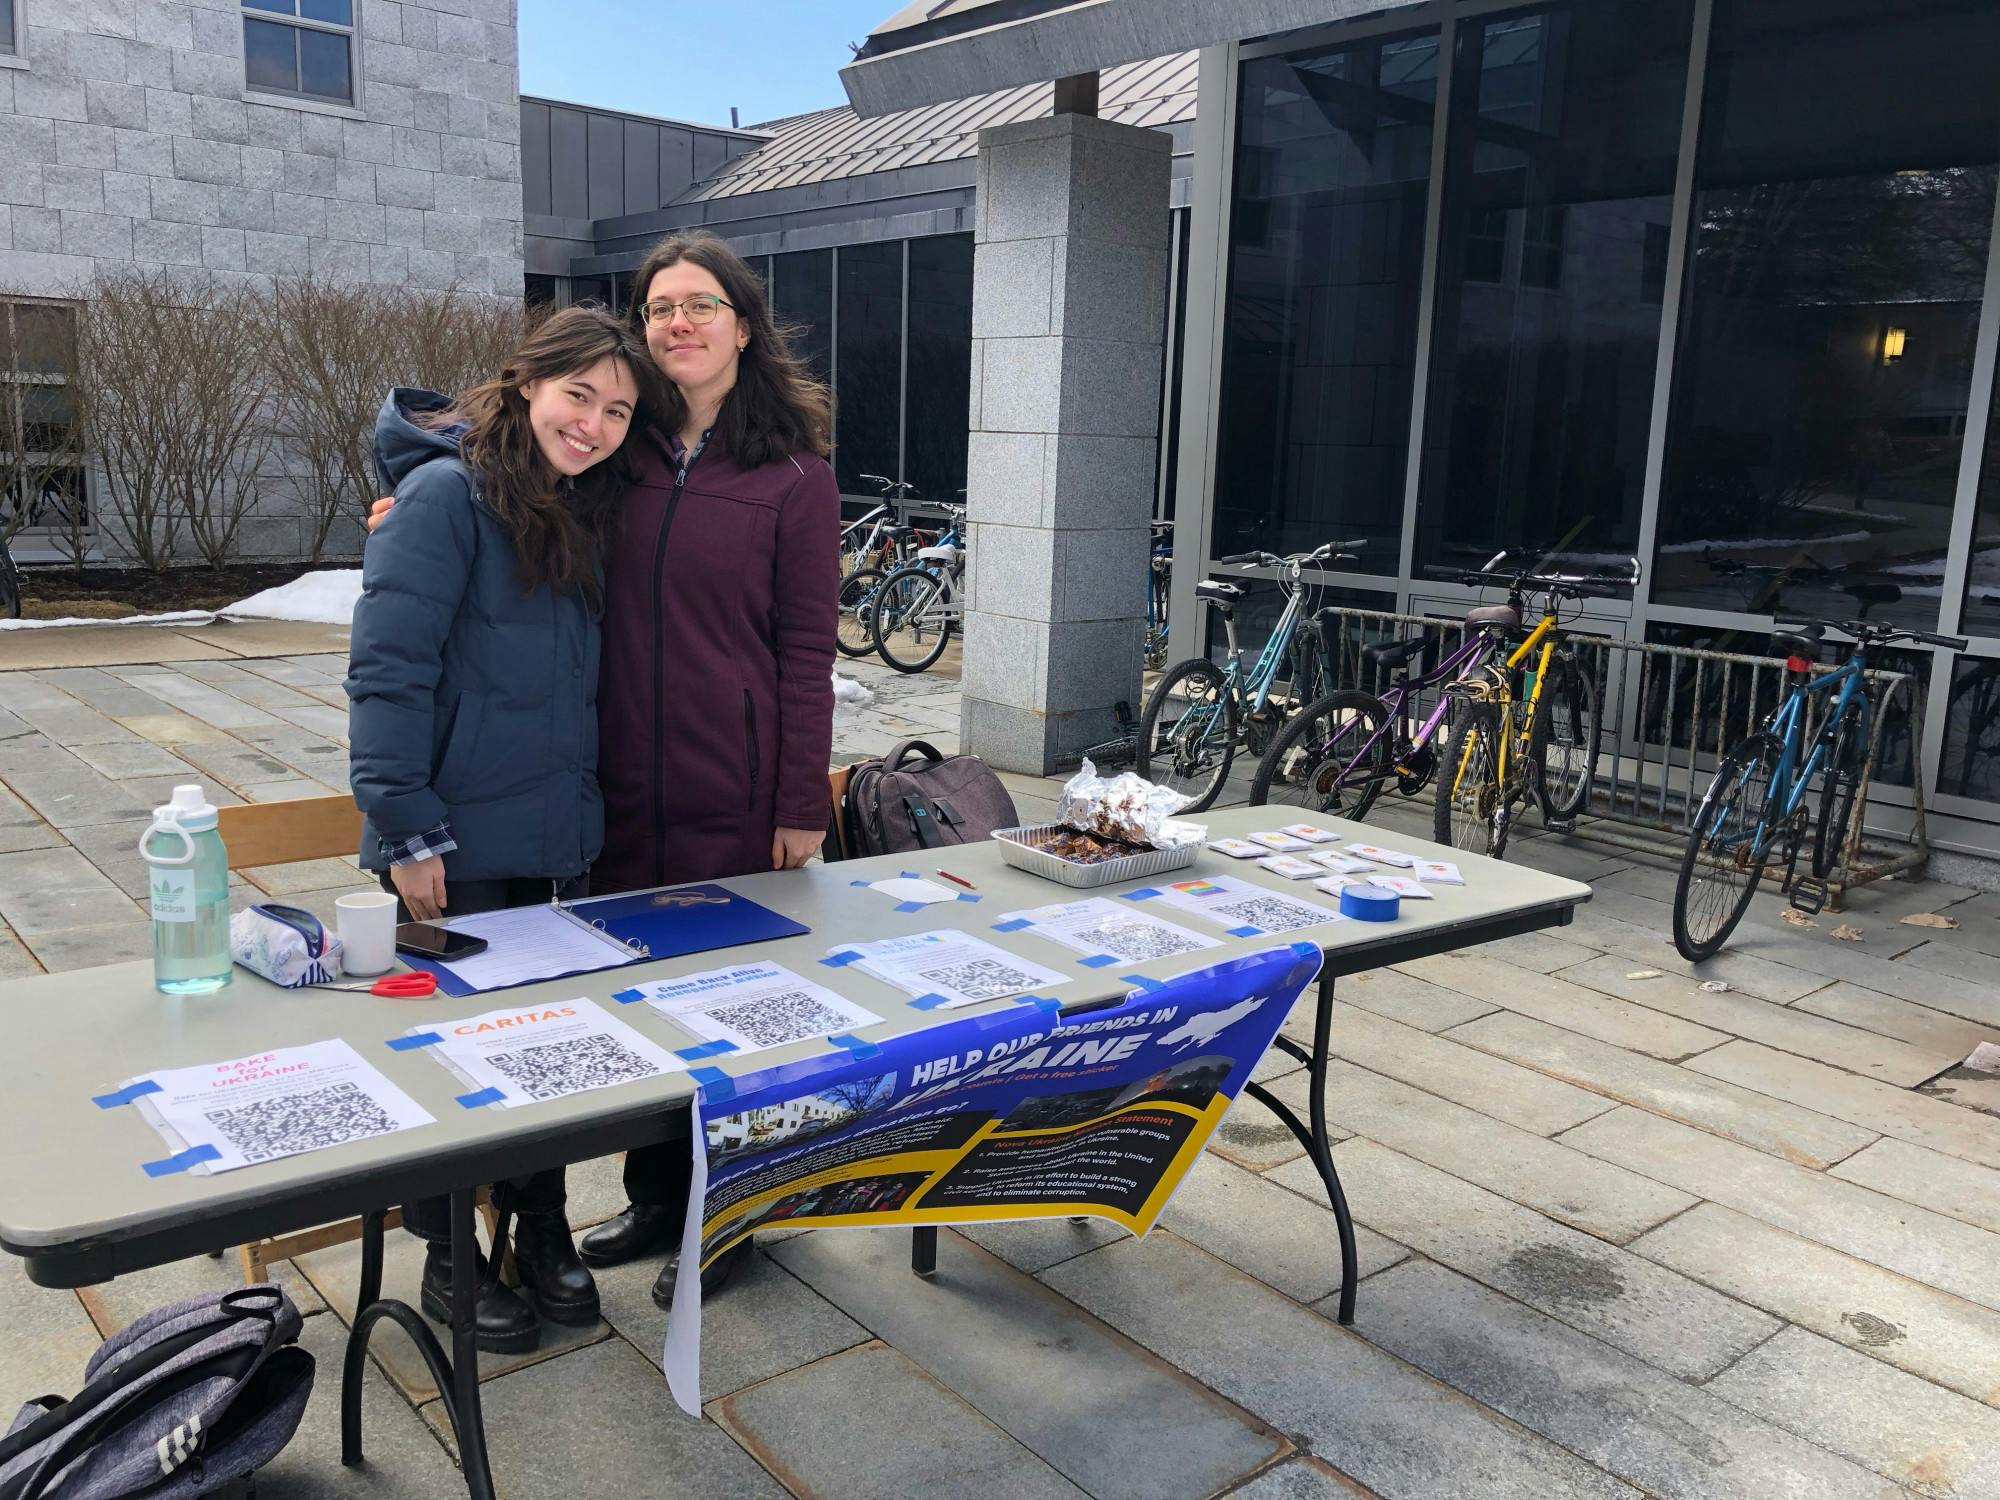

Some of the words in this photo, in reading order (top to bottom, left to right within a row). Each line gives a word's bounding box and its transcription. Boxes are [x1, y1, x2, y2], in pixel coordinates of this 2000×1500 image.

[153, 903, 186, 913] adidas
[657, 982, 697, 993] Come
[696, 975, 730, 985] Back
[731, 967, 764, 978] Alive
[454, 1007, 577, 1036] CARITAS
[910, 1049, 983, 1087] HELP
[986, 1032, 1045, 1062] OUR
[1045, 1010, 1148, 1041] FRIENDS
[1150, 1006, 1179, 1025] IN
[217, 1054, 277, 1073] BAKE
[238, 1064, 268, 1076] for
[212, 1062, 310, 1088] UKRAINE
[1015, 1072, 1038, 1081] Get
[1050, 1069, 1074, 1079] free
[1114, 1114, 1174, 1126] Statement
[804, 1134, 853, 1154] your
[853, 1110, 934, 1137] donation
[933, 1101, 969, 1115] go?
[987, 1149, 1020, 1158] Provide
[1097, 1127, 1138, 1136] vulnerable
[1139, 1129, 1170, 1141] groups
[1108, 1150, 1123, 1158] the
[1124, 1151, 1154, 1164] United
[1046, 1180, 1096, 1188] educational
[1096, 1181, 1128, 1194] system,
[1109, 1175, 1138, 1187] strong
[1003, 1188, 1041, 1196] eliminate
